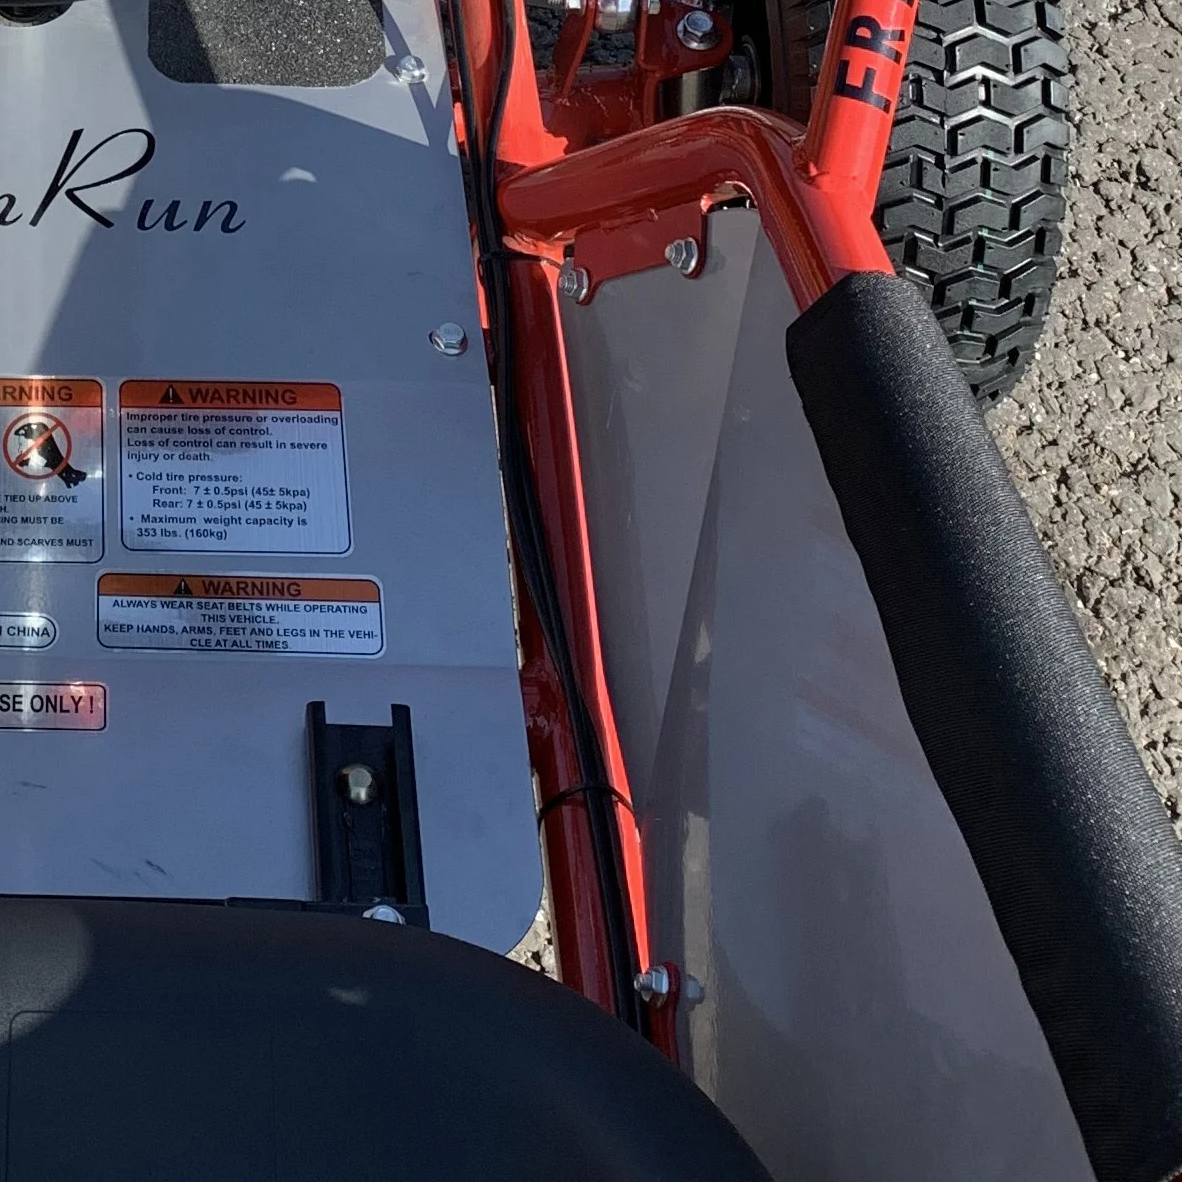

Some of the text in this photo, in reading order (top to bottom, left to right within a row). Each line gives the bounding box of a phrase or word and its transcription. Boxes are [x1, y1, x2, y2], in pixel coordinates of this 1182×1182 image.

[188, 388, 298, 404] WARNING
[126, 413, 178, 422] Improper
[180, 413, 199, 421] tire
[202, 414, 252, 423] pressure
[271, 414, 339, 425] overloading
[150, 426, 183, 434] cause
[187, 425, 211, 434] loss
[214, 425, 226, 434] of
[127, 438, 154, 447] Loss
[157, 438, 169, 447] of
[172, 438, 212, 447] control
[215, 440, 236, 448] can
[239, 440, 272, 448] result
[275, 439, 286, 449] in
[127, 450, 159, 462] injury
[162, 449, 175, 460] or
[136, 471, 243, 482] Cold tire pressure:
[152, 485, 186, 494] Front:
[193, 485, 200, 494] 7
[203, 486, 210, 495] ±
[213, 486, 248, 497] 0.5psi
[278, 487, 311, 498] 5kpa)
[3, 495, 26, 503] TIED
[28, 495, 41, 503] UP
[43, 495, 78, 503] ABOVE
[152, 498, 307, 512] Rear: 7 ± 0.5psi (45 ± 5kpa)
[20, 516, 48, 524] MUST
[140, 514, 308, 527] Maximum weight capacity is
[137, 527, 157, 537] 353
[184, 528, 228, 540] (160kg)
[16, 538, 63, 546] SCARVES
[66, 539, 94, 547] MUST
[202, 581, 302, 597] WARNING
[112, 599, 368, 614] ALWAYS WEAR SEAT BELTS WHILE OPERATING
[201, 613, 226, 623] THIS
[6, 626, 51, 637] CHINA
[104, 624, 133, 634] KEEP
[219, 627, 246, 636] FEET
[249, 627, 273, 637] AND
[276, 628, 306, 638] LEGS
[309, 629, 320, 638] IN
[322, 629, 345, 639] THE
[190, 638, 211, 648] CLE
[214, 639, 228, 648] AT
[230, 639, 252, 649] ALL
[29, 694, 82, 714] ONLY
